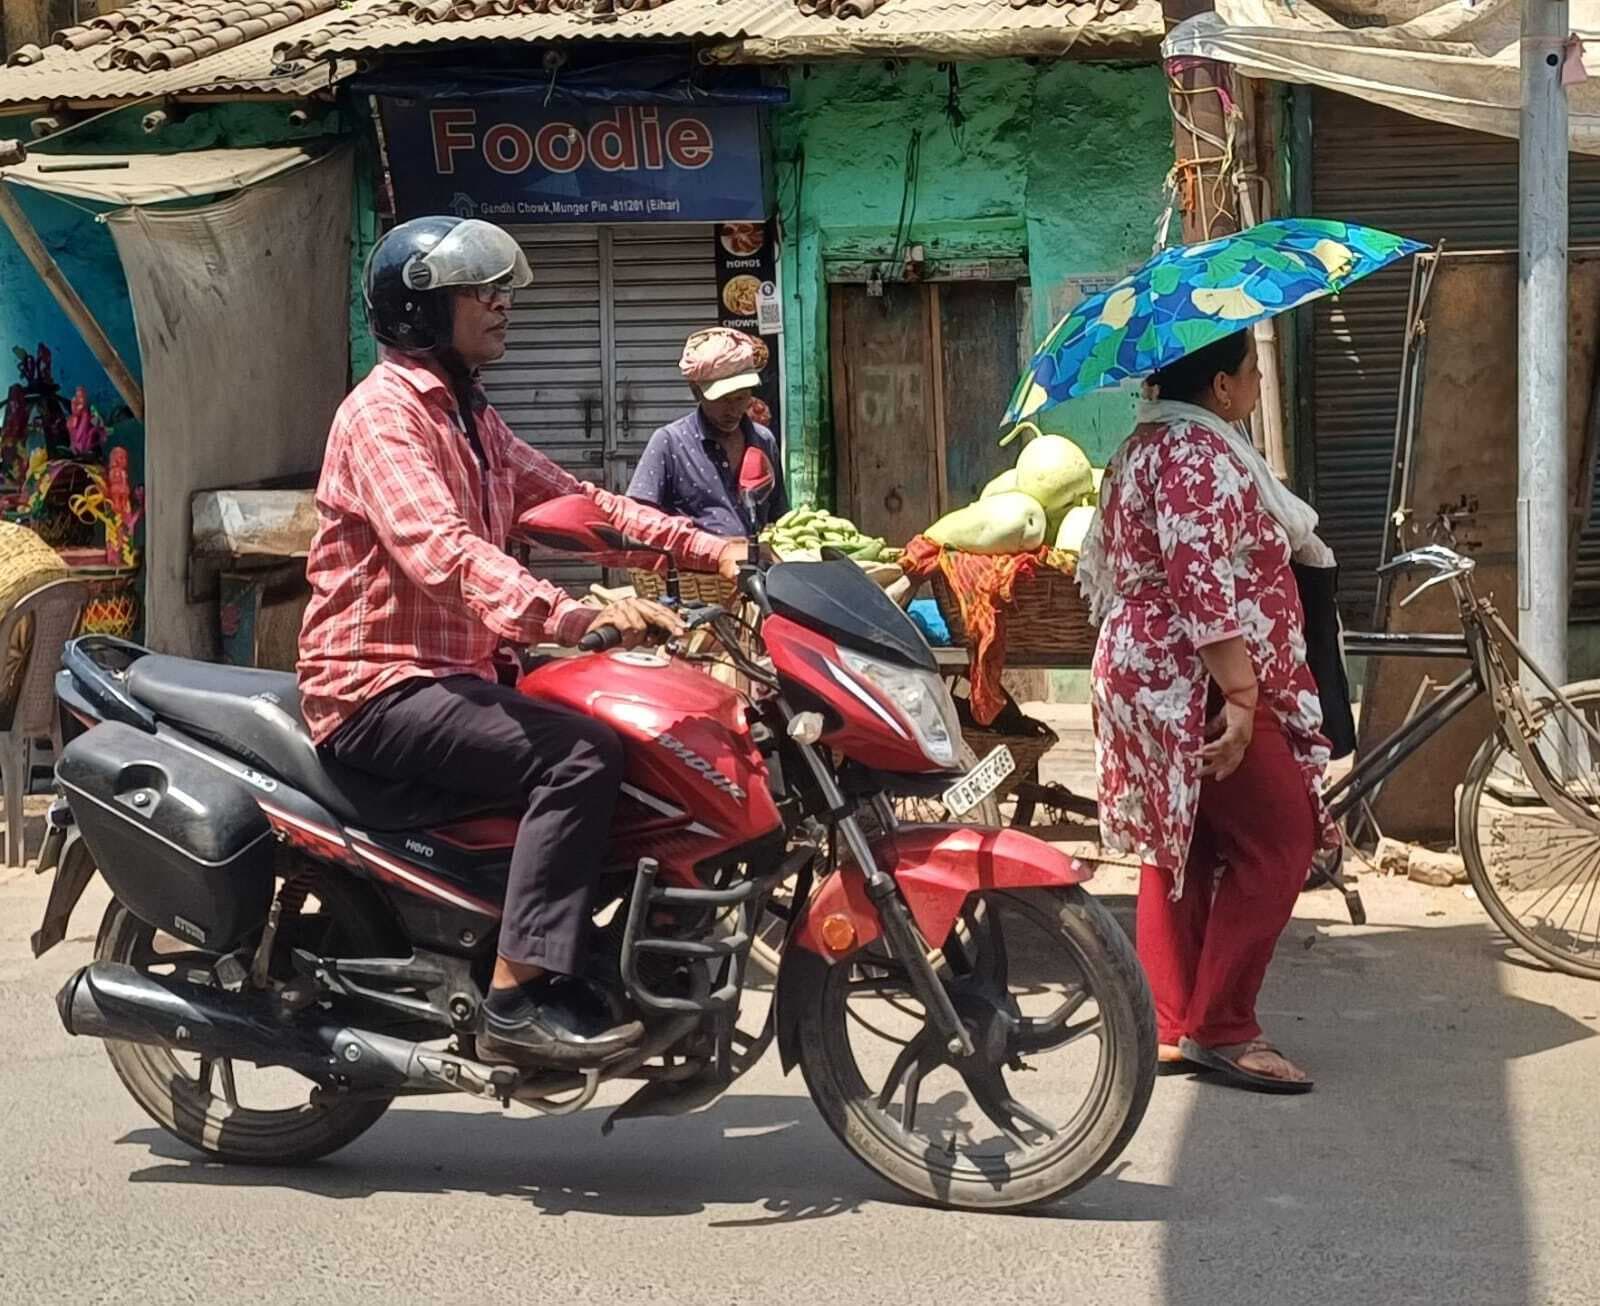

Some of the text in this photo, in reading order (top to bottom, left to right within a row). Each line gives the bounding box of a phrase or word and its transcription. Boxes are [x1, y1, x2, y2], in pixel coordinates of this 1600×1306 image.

[429, 105, 714, 175] Foodie
[480, 201, 516, 214] Gandhi
[591, 199, 608, 212] Pin
[725, 258, 762, 269] MOMOS
[405, 838, 435, 858] Hero
